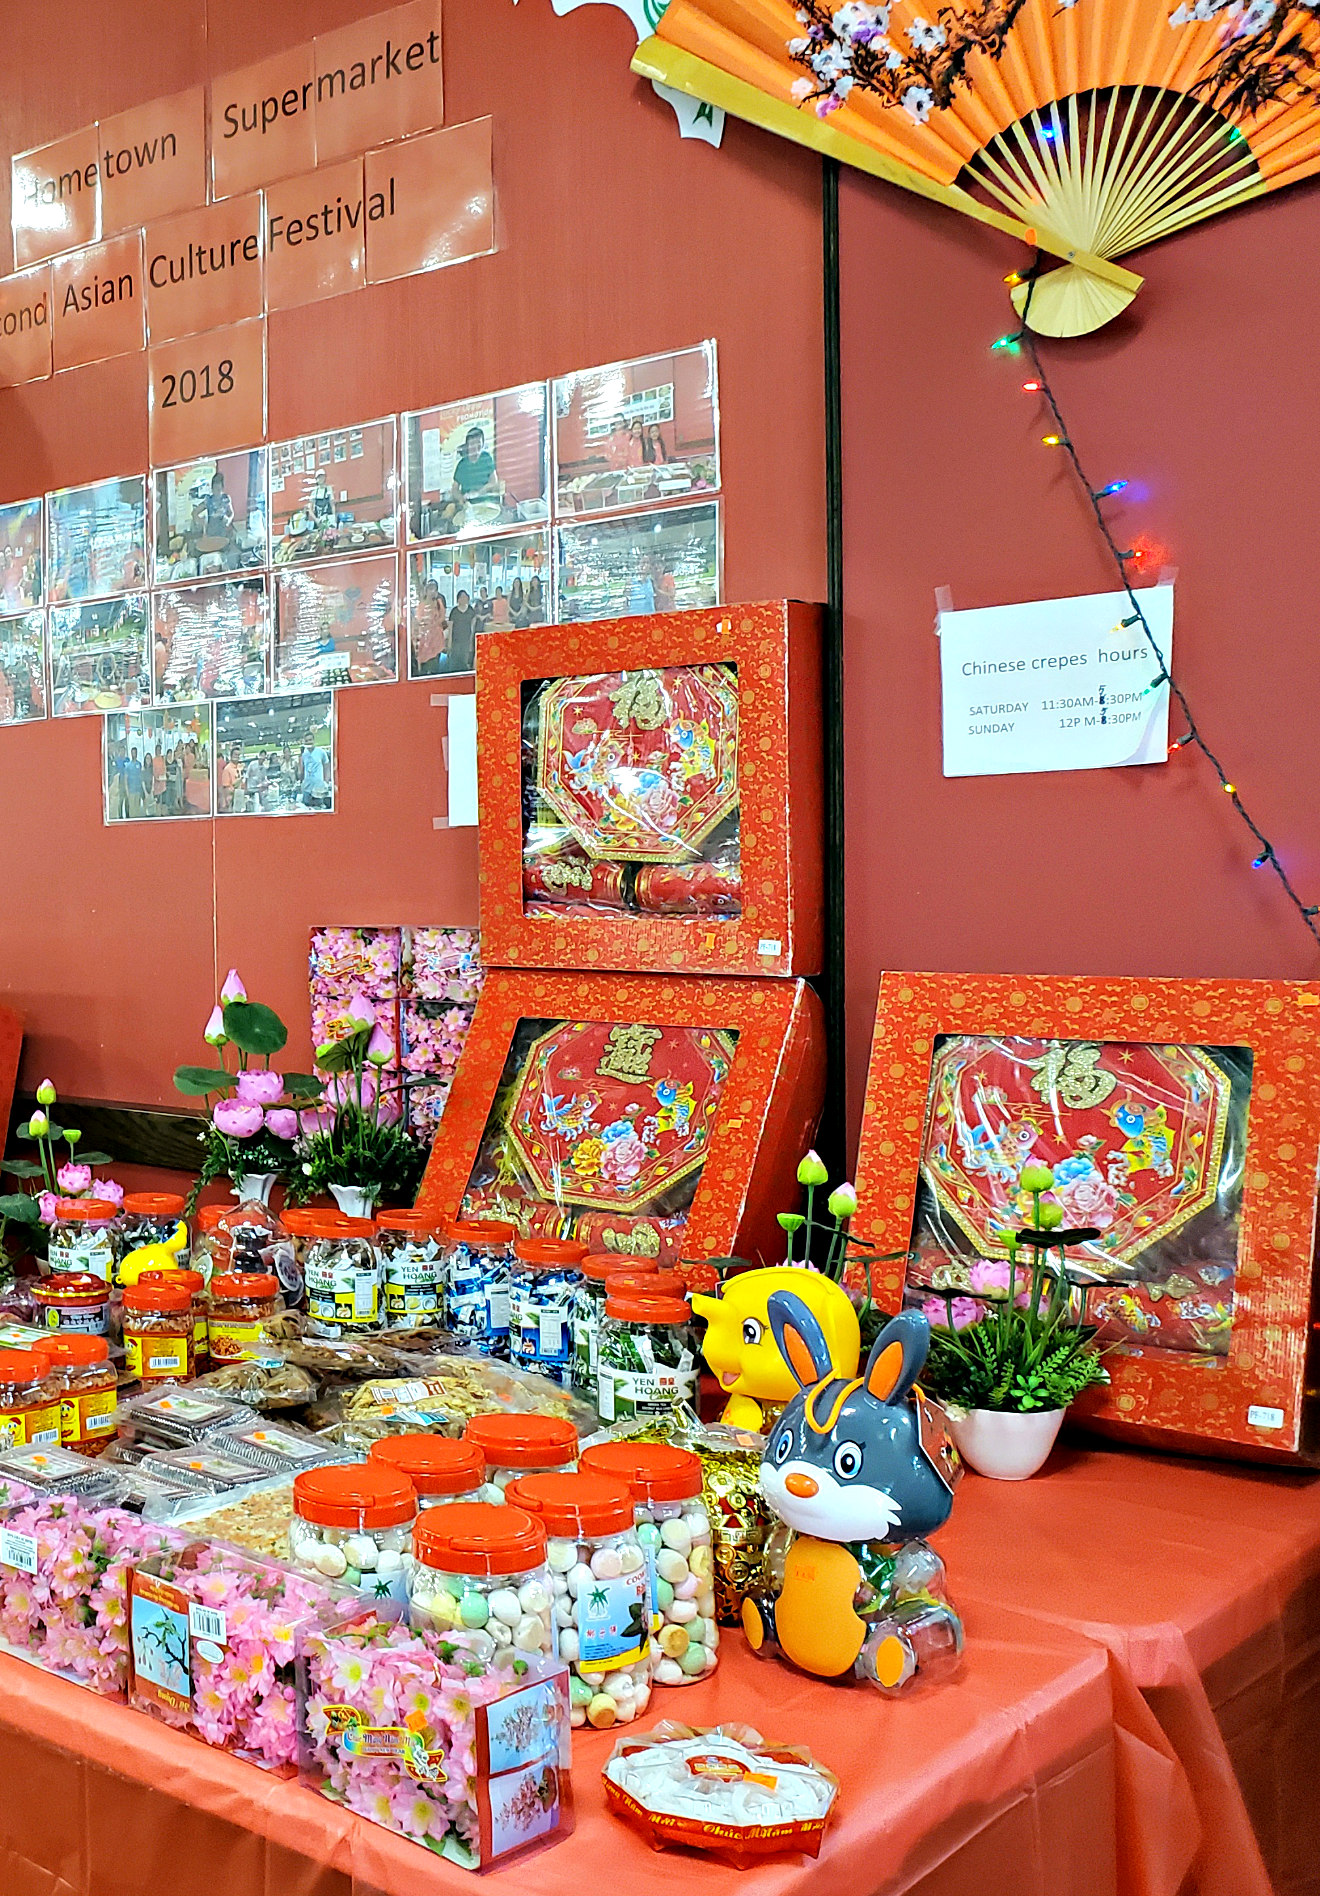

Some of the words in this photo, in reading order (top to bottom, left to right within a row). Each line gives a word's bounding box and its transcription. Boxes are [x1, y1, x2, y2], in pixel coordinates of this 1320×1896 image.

[223, 29, 440, 140] Supermarket
[61, 269, 134, 318] Asian
[148, 230, 260, 290] Culture
[268, 178, 396, 254] Festival
[160, 359, 236, 410] 2018
[961, 661, 1027, 677] Chinese
[1031, 653, 1088, 673] crepes
[1098, 647, 1149, 663] hours
[969, 701, 1029, 716] SATURDAY
[968, 722, 1015, 735] SUNDAY
[308, 1276, 337, 1287] HOANG
[403, 1272, 437, 1280] HOANG
[632, 1377, 655, 1386] YEN
[634, 1387, 679, 1395] HOANG
